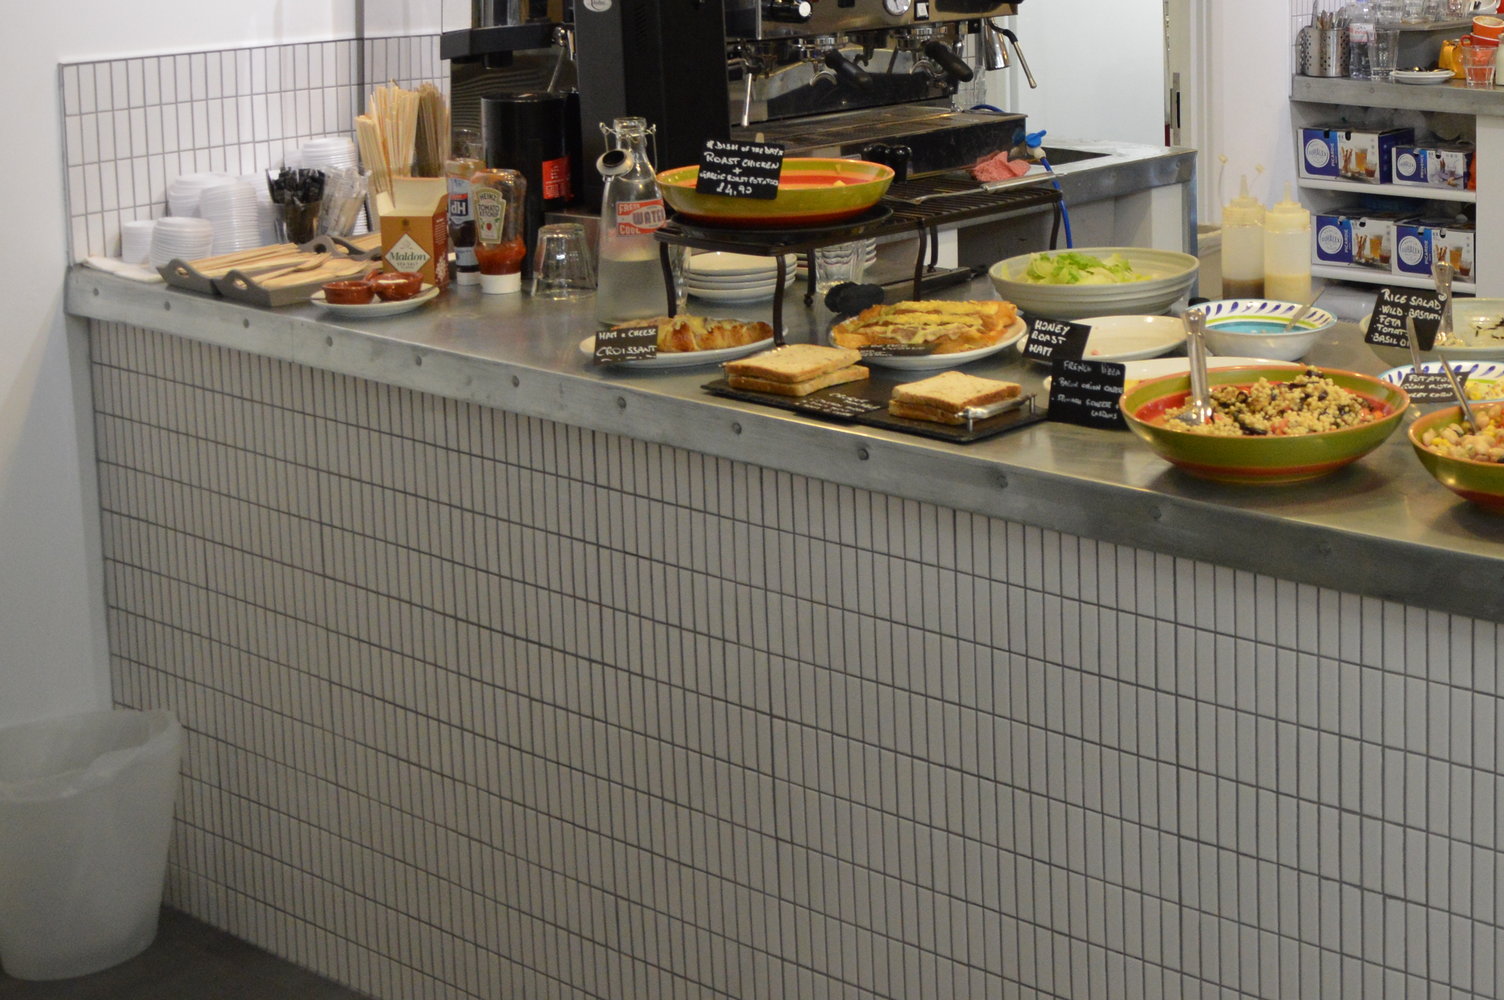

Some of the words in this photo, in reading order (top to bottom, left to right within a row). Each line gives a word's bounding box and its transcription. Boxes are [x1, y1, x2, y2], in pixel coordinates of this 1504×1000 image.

[703, 151, 741, 165] ROAST
[741, 158, 780, 170] CHICKEN
[451, 200, 466, 216] HP
[478, 203, 500, 211] TOMATO
[390, 251, 426, 261] Maldon
[1381, 288, 1408, 304] RICE
[1408, 296, 1442, 310] SALAD
[1381, 304, 1404, 316] WILD
[1034, 319, 1070, 335] HONEY
[1378, 314, 1401, 327] FETA
[1031, 330, 1067, 344] ROAST
[1372, 332, 1398, 344] BASIL
[596, 345, 658, 357] CROISSANT
[1028, 343, 1053, 356] HAM
